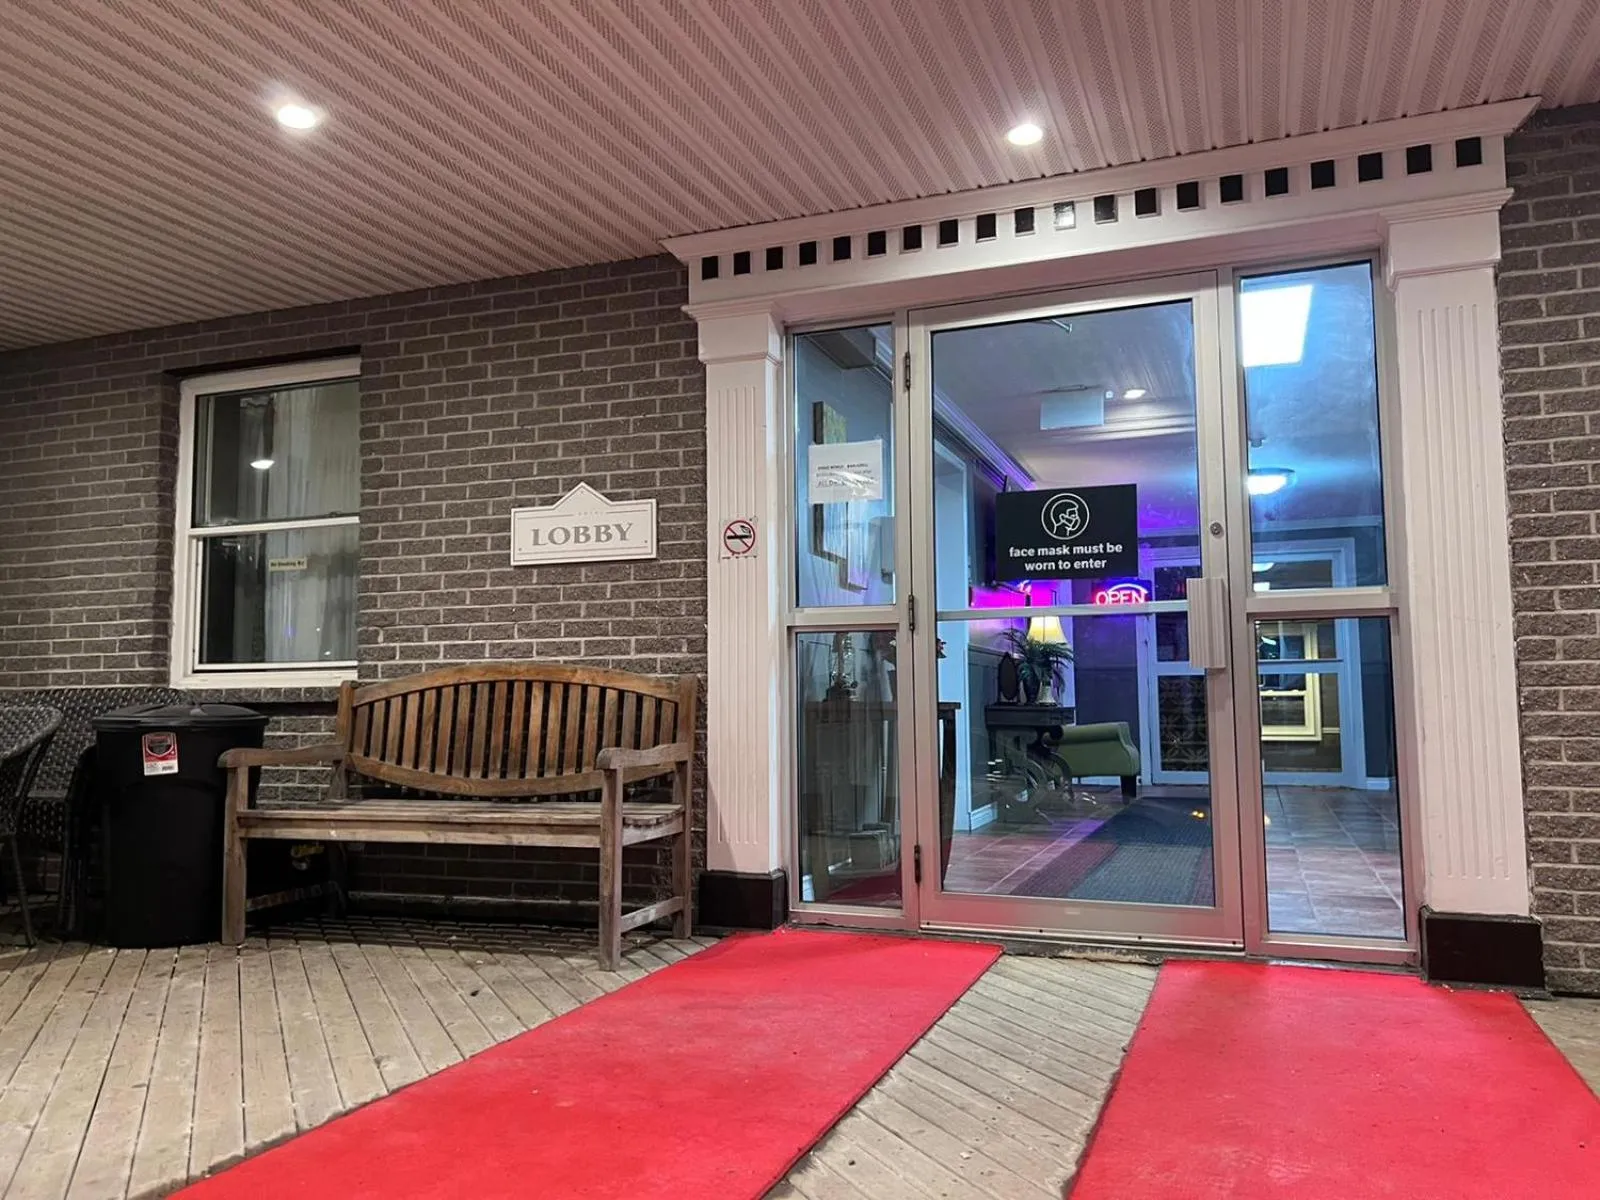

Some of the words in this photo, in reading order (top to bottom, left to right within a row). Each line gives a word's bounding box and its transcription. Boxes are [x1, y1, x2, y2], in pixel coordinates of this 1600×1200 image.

[531, 522, 633, 546] LOBBY
[1009, 546, 1035, 557] face
[1037, 544, 1070, 556] mask
[1072, 543, 1104, 554] must
[1106, 541, 1123, 553] be
[1024, 560, 1056, 571] worn
[1057, 559, 1071, 570] to
[1073, 558, 1107, 569] enter
[1095, 589, 1146, 606] OPEN
